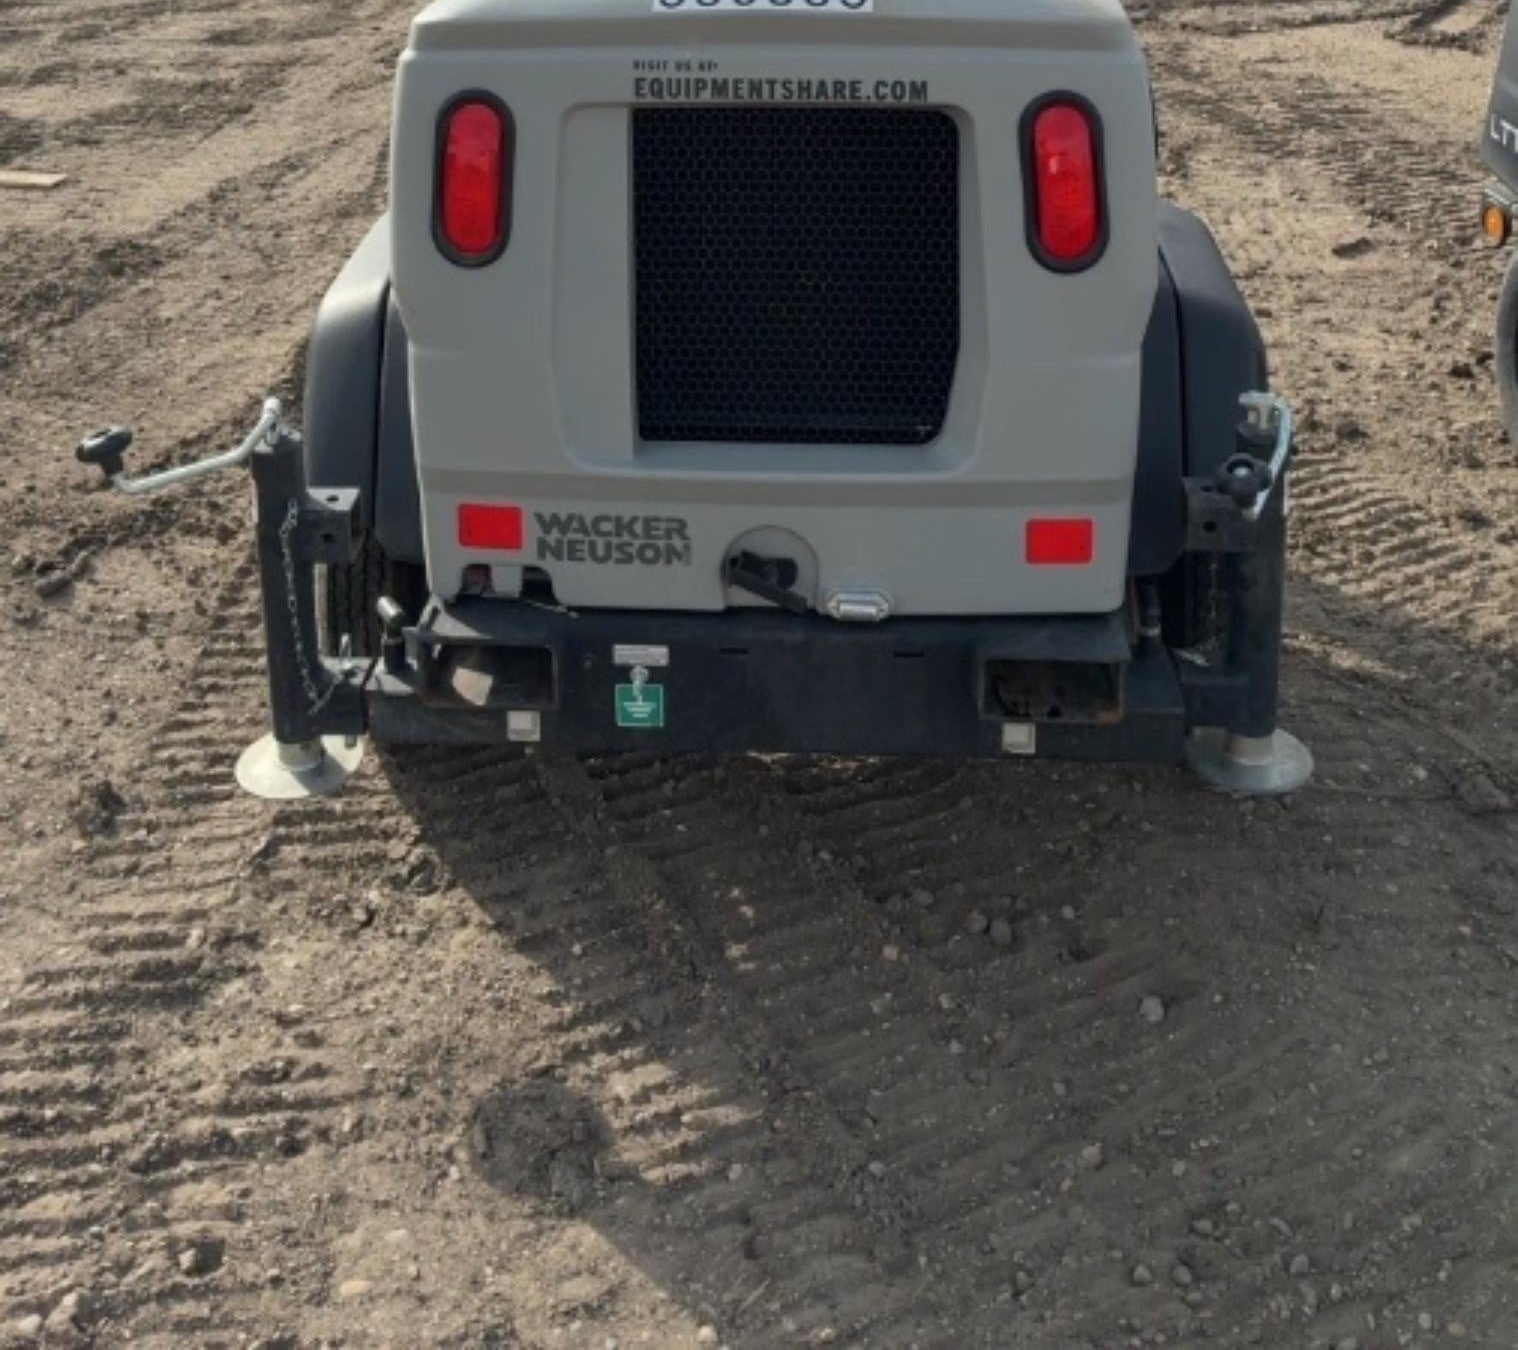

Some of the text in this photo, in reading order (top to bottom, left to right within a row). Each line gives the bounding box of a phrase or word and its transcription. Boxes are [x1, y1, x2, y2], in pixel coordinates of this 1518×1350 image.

[632, 59, 669, 71] VISIT
[634, 77, 929, 101] EQUIPMENTSHARE.COM
[534, 512, 691, 540] WACKER
[536, 537, 692, 566] NEUSON
